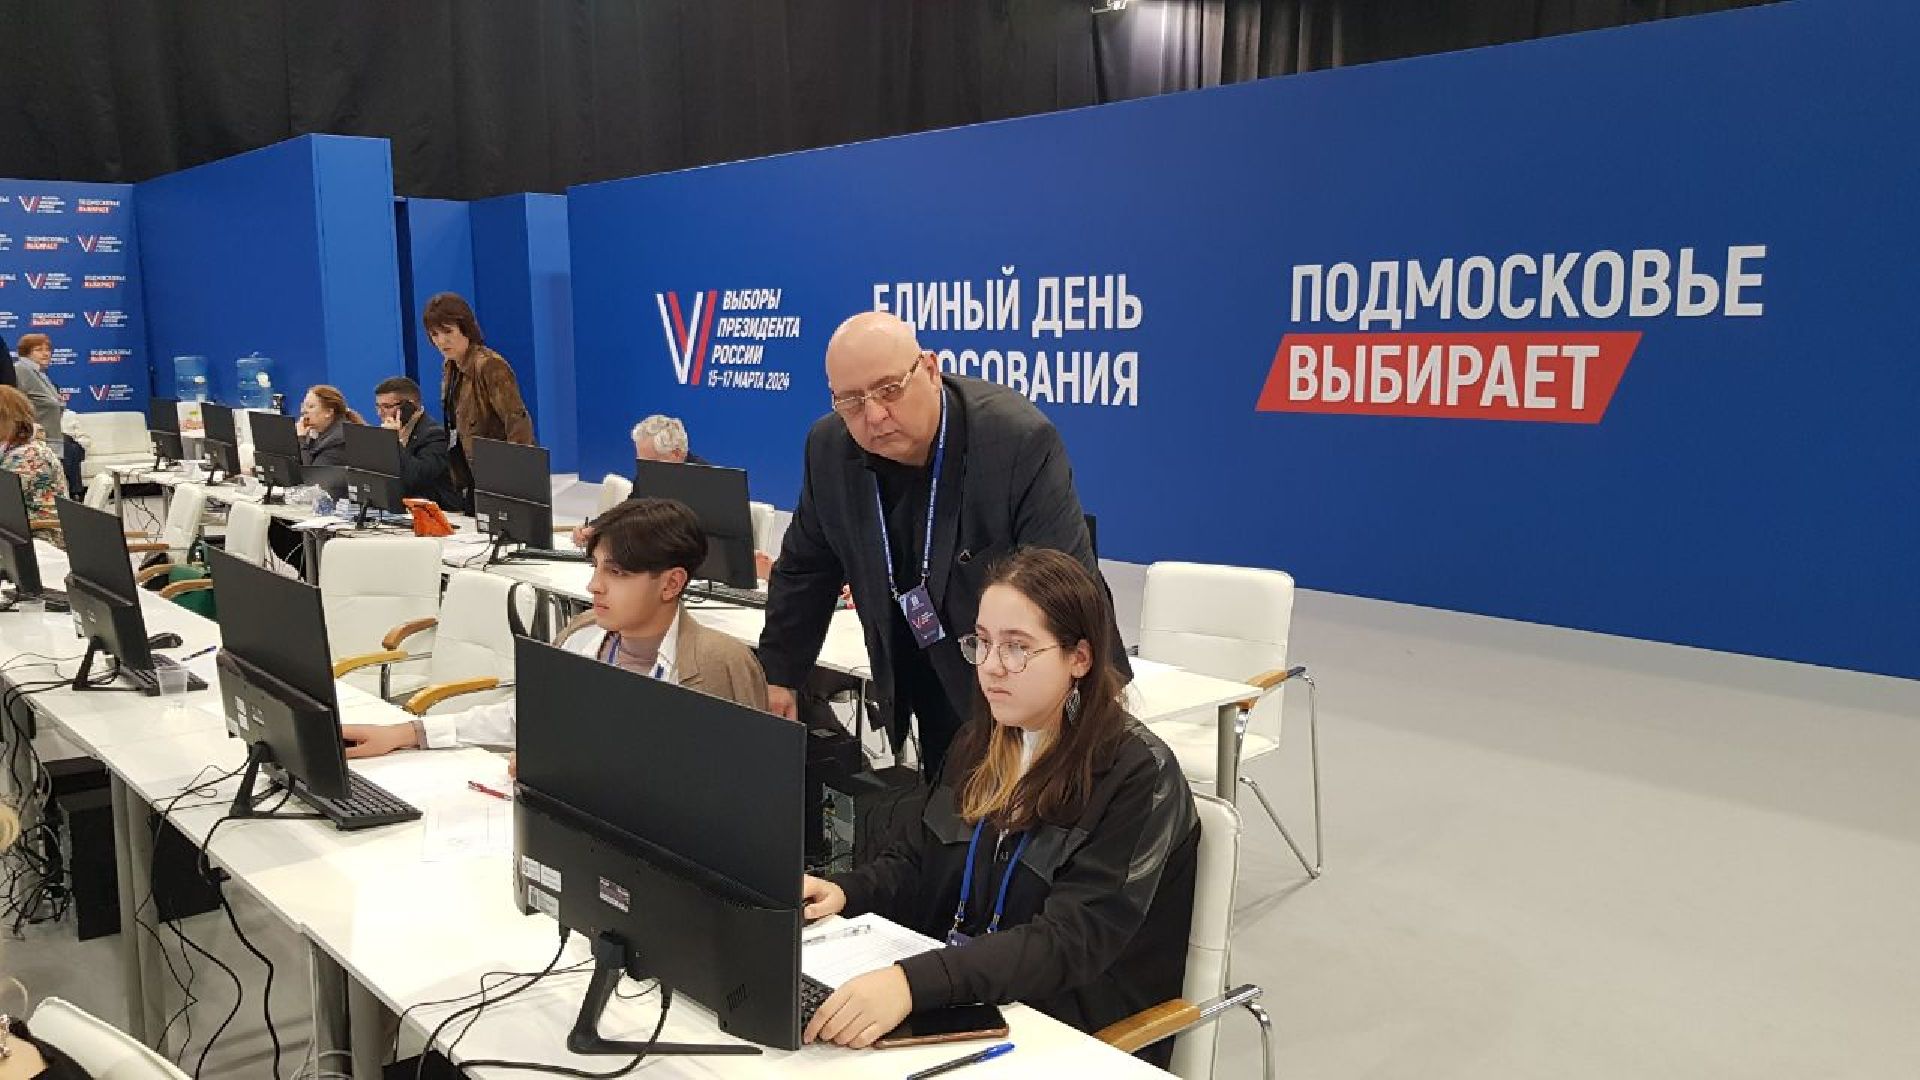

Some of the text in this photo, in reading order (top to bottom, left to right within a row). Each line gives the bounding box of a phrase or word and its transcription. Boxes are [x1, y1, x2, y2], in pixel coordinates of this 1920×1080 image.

[722, 288, 782, 311] ВЫБОРЫ
[1291, 246, 1766, 331] ПОДМОСКОВЬЕ
[874, 265, 1142, 338] ЕДИНЫЙ ДЕНЬ
[716, 316, 801, 340] ПРЕЗИДЕНТА
[711, 344, 764, 364] РОССИИ
[732, 371, 764, 389] МАРТА
[765, 372, 790, 391] 2024
[1289, 344, 1600, 410] ВЫБИРАЕТ
